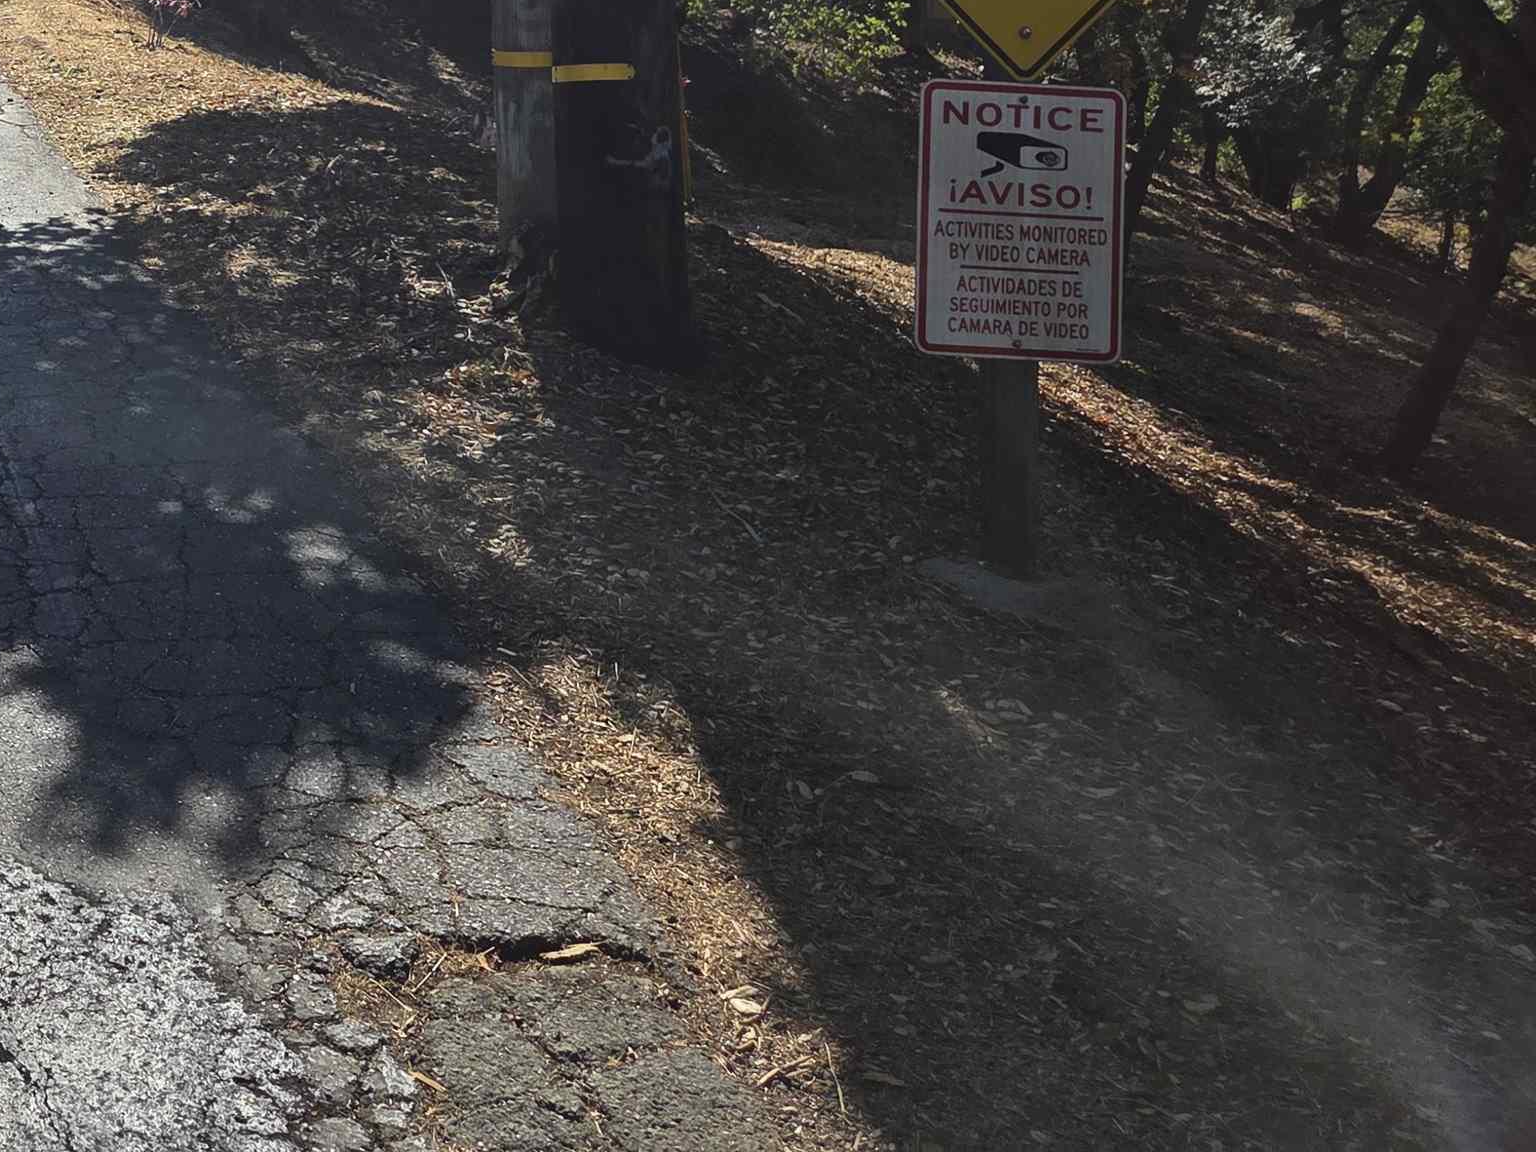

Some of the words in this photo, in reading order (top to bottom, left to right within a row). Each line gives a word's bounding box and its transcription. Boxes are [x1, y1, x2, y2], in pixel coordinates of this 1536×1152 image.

[943, 100, 1104, 133] NOTICE
[950, 179, 1093, 210] ¡AVISO!
[934, 220, 1014, 241] ACTIVITIES
[1019, 225, 1108, 246] MONITORED
[949, 243, 970, 260] BY
[975, 244, 1020, 264] VIDEO
[1026, 248, 1090, 267] CAMERA
[956, 276, 1057, 297] ACTIVIDADES
[1062, 281, 1083, 298] DE
[949, 297, 1052, 318] SEGUIMIENTO
[1056, 302, 1088, 319] POR
[948, 317, 1013, 336] CAMARA
[1018, 320, 1039, 336] DE
[1043, 323, 1089, 341] VIDEO
